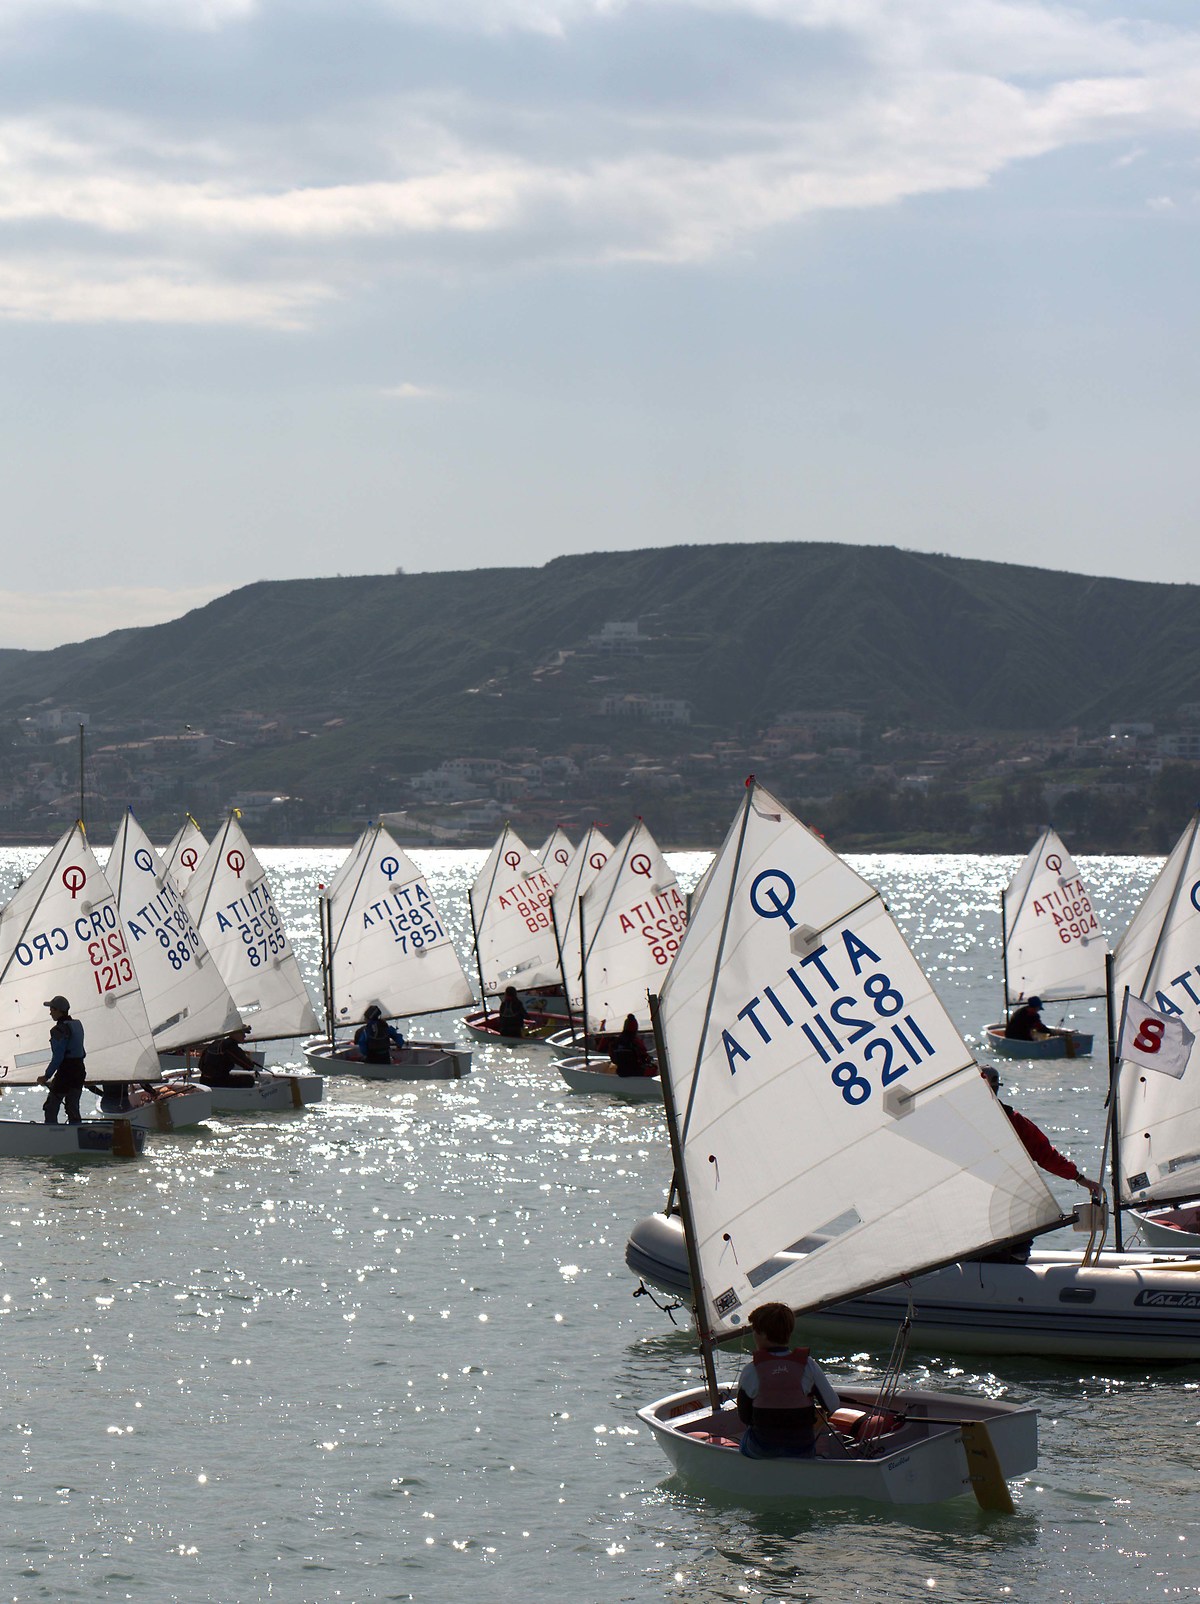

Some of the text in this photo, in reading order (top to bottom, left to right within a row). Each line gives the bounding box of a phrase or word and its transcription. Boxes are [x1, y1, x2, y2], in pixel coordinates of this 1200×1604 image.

[75, 905, 116, 942] CRO
[395, 921, 444, 954] 7851
[1059, 914, 1098, 944] 6904
[168, 926, 198, 970] 8876
[248, 928, 286, 967] 8755
[94, 958, 132, 994] 1213
[830, 1014, 936, 1106] 8211
